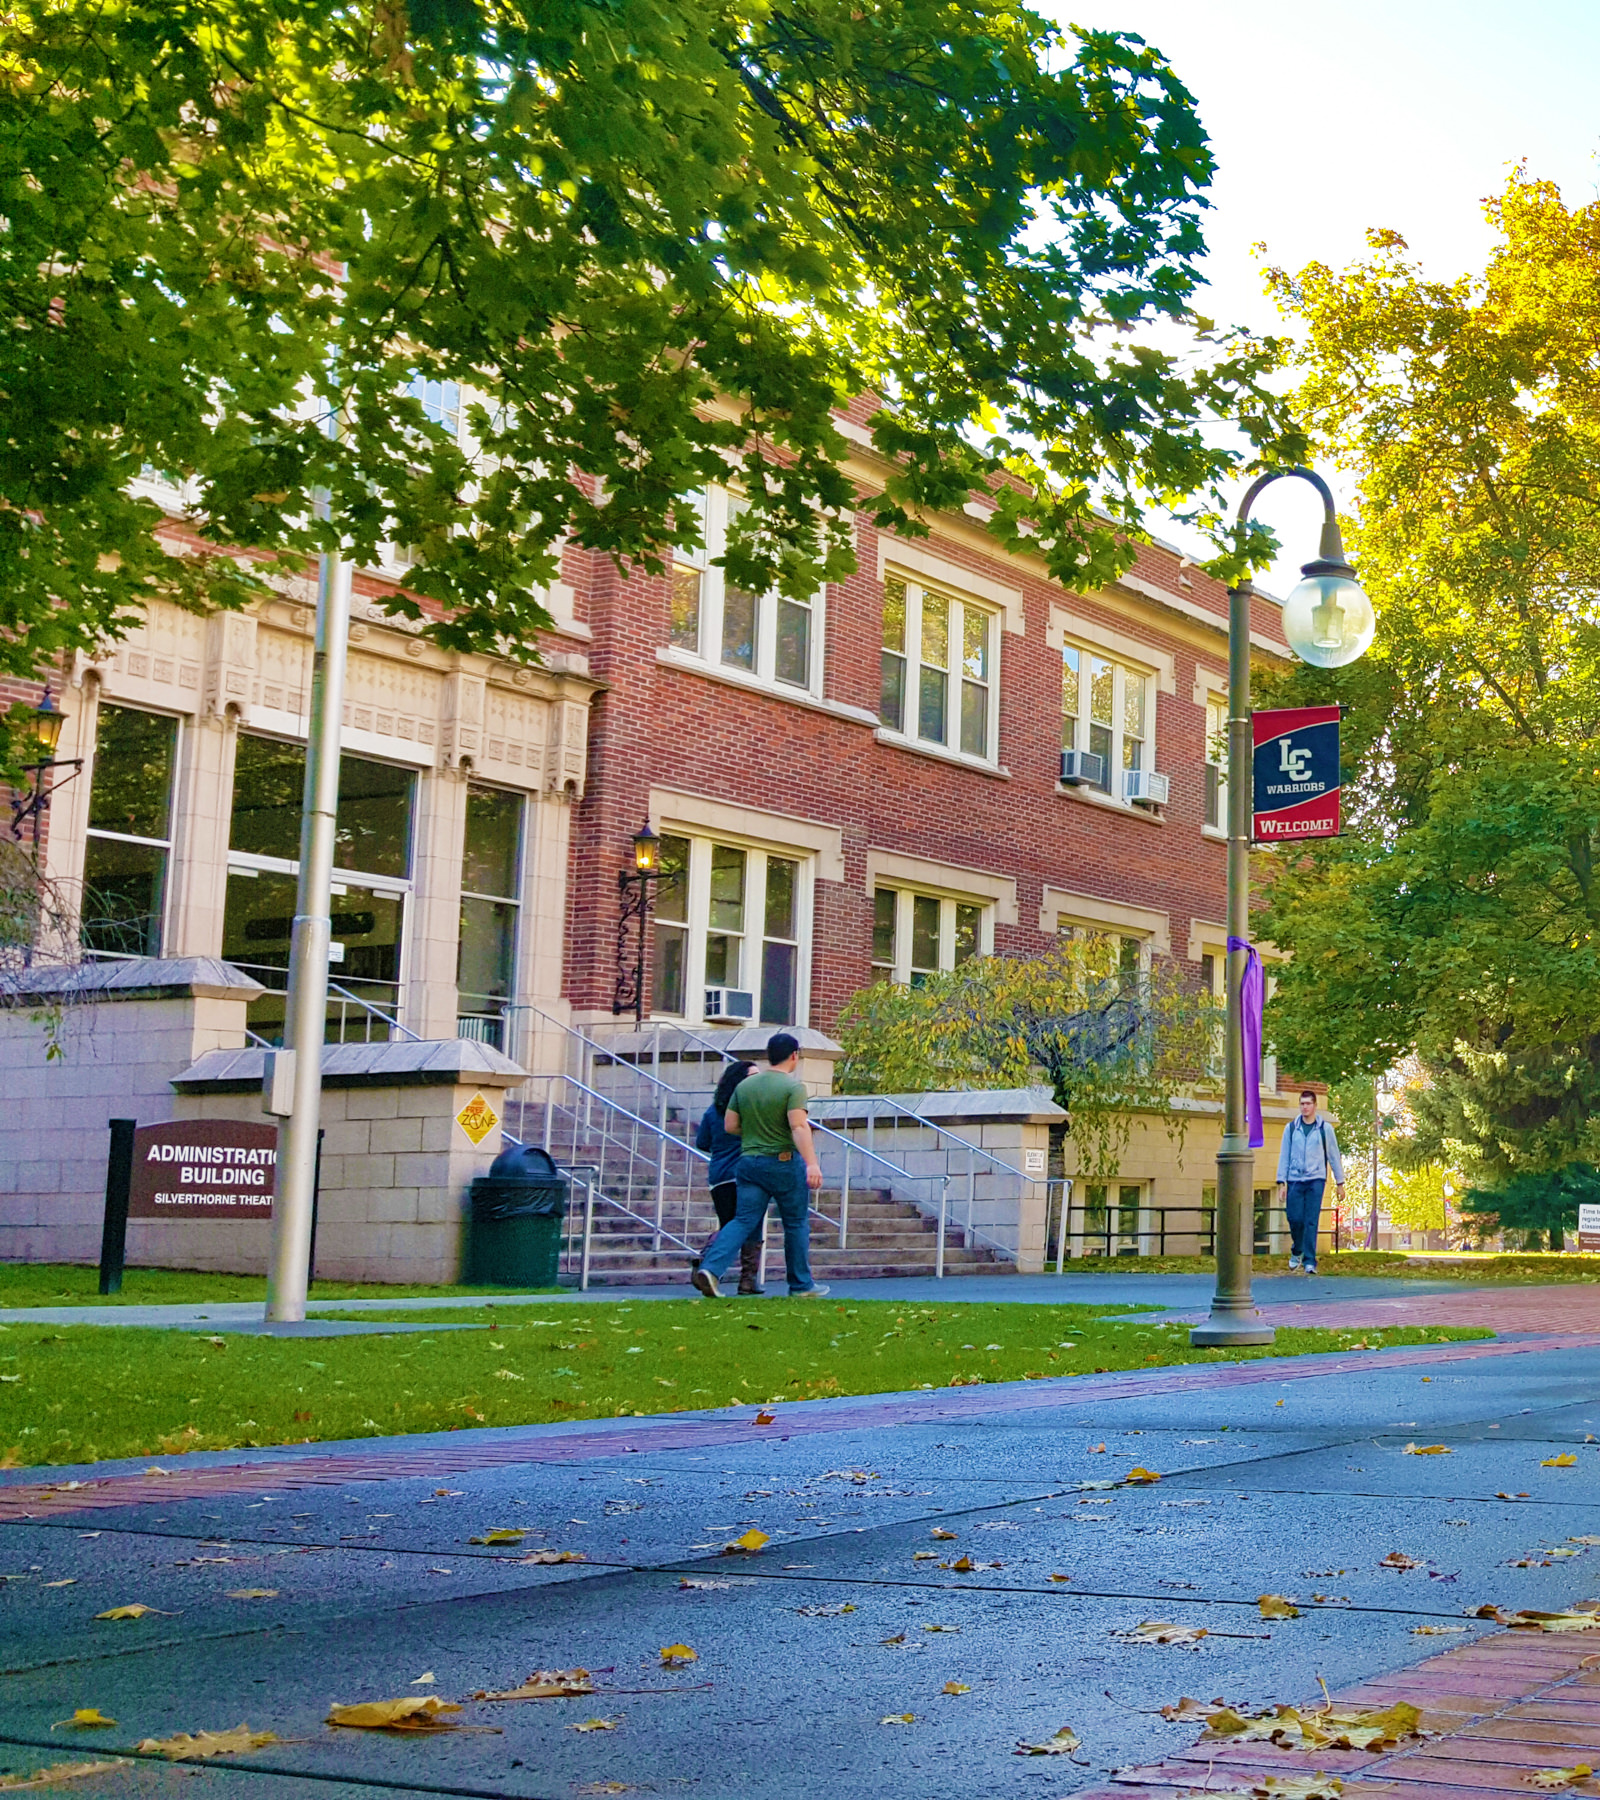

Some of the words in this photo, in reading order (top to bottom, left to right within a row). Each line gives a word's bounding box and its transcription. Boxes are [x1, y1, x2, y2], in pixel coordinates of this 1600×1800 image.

[1279, 739, 1312, 781] LC
[1267, 782, 1325, 794] WARRIORS
[461, 1113, 496, 1130] ZONE
[180, 1166, 265, 1185] BUILDING
[154, 1192, 236, 1205] SILVERTHORNE
[239, 1195, 274, 1206] THEAT
